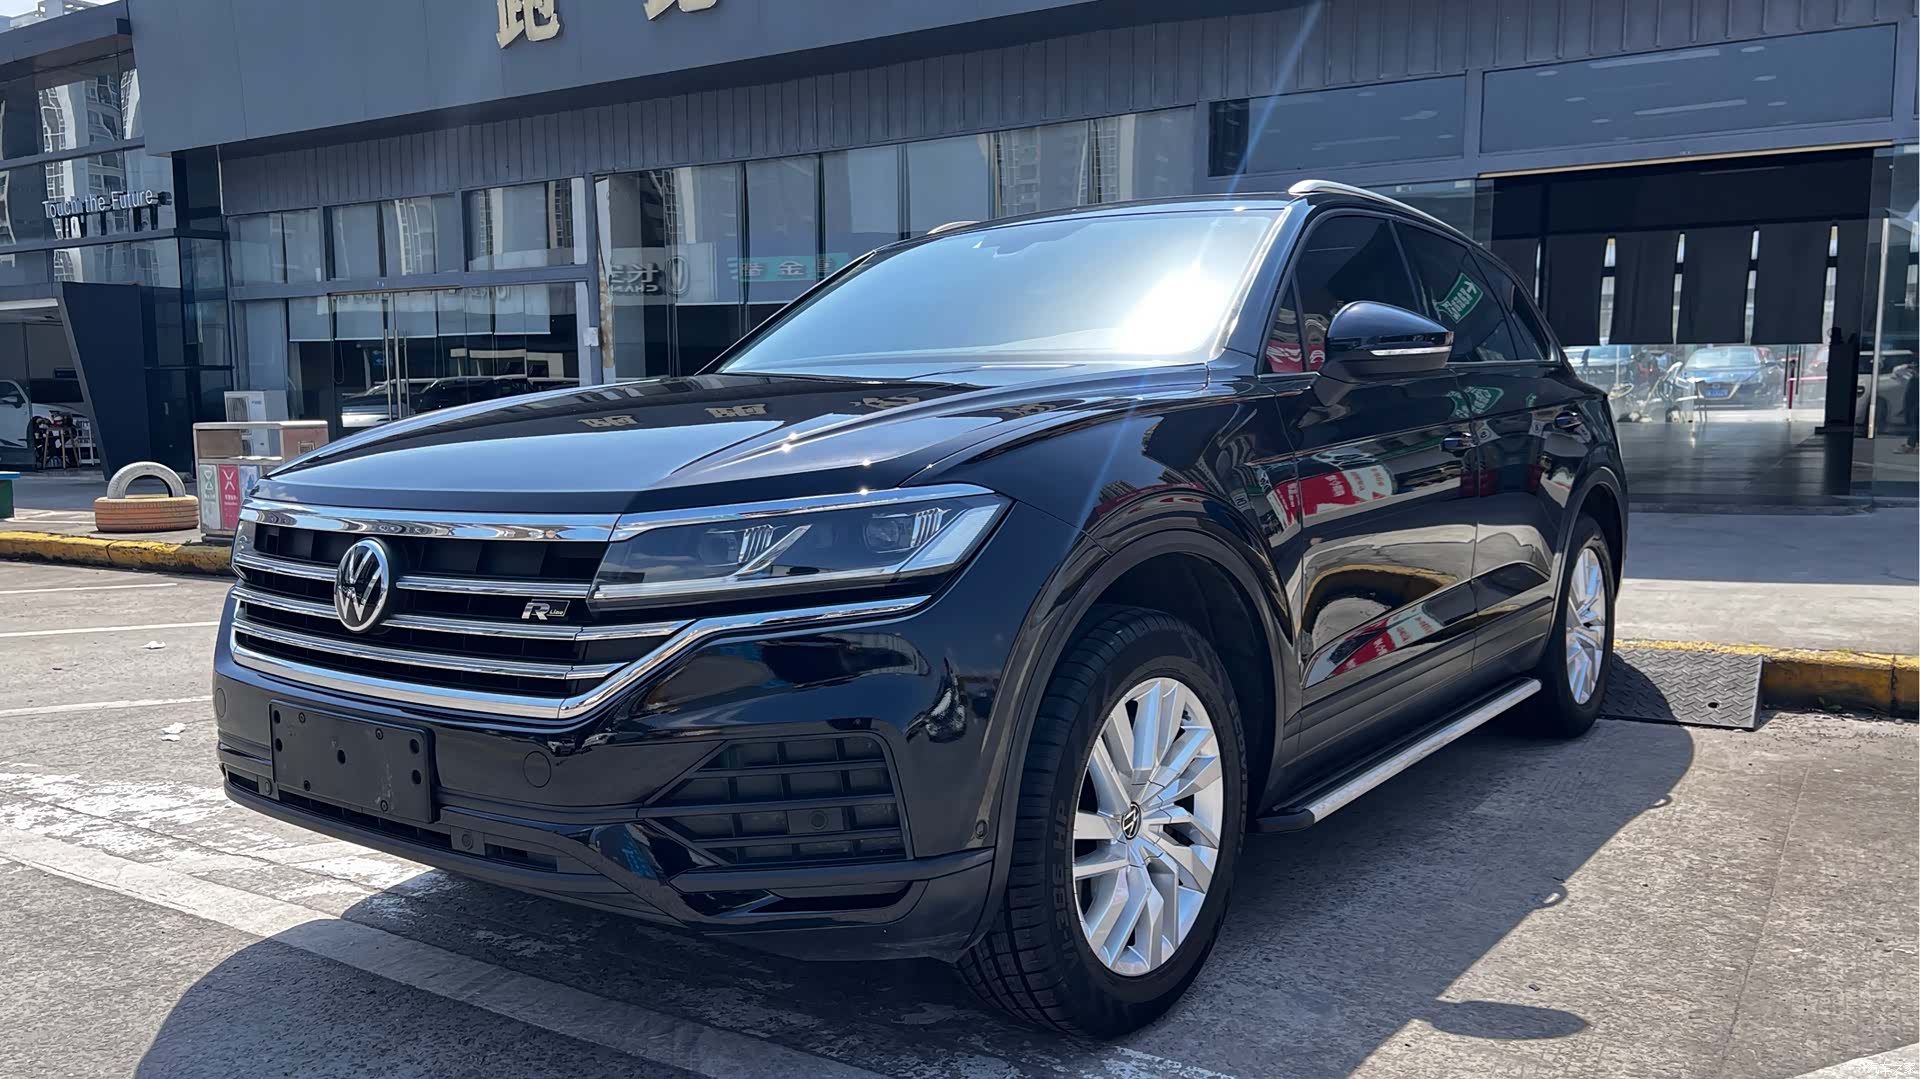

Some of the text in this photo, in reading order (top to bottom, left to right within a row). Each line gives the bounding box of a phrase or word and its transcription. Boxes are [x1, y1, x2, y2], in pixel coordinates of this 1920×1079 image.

[85, 193, 106, 213] the
[110, 189, 154, 211] Future
[1052, 798, 1069, 850] HP
